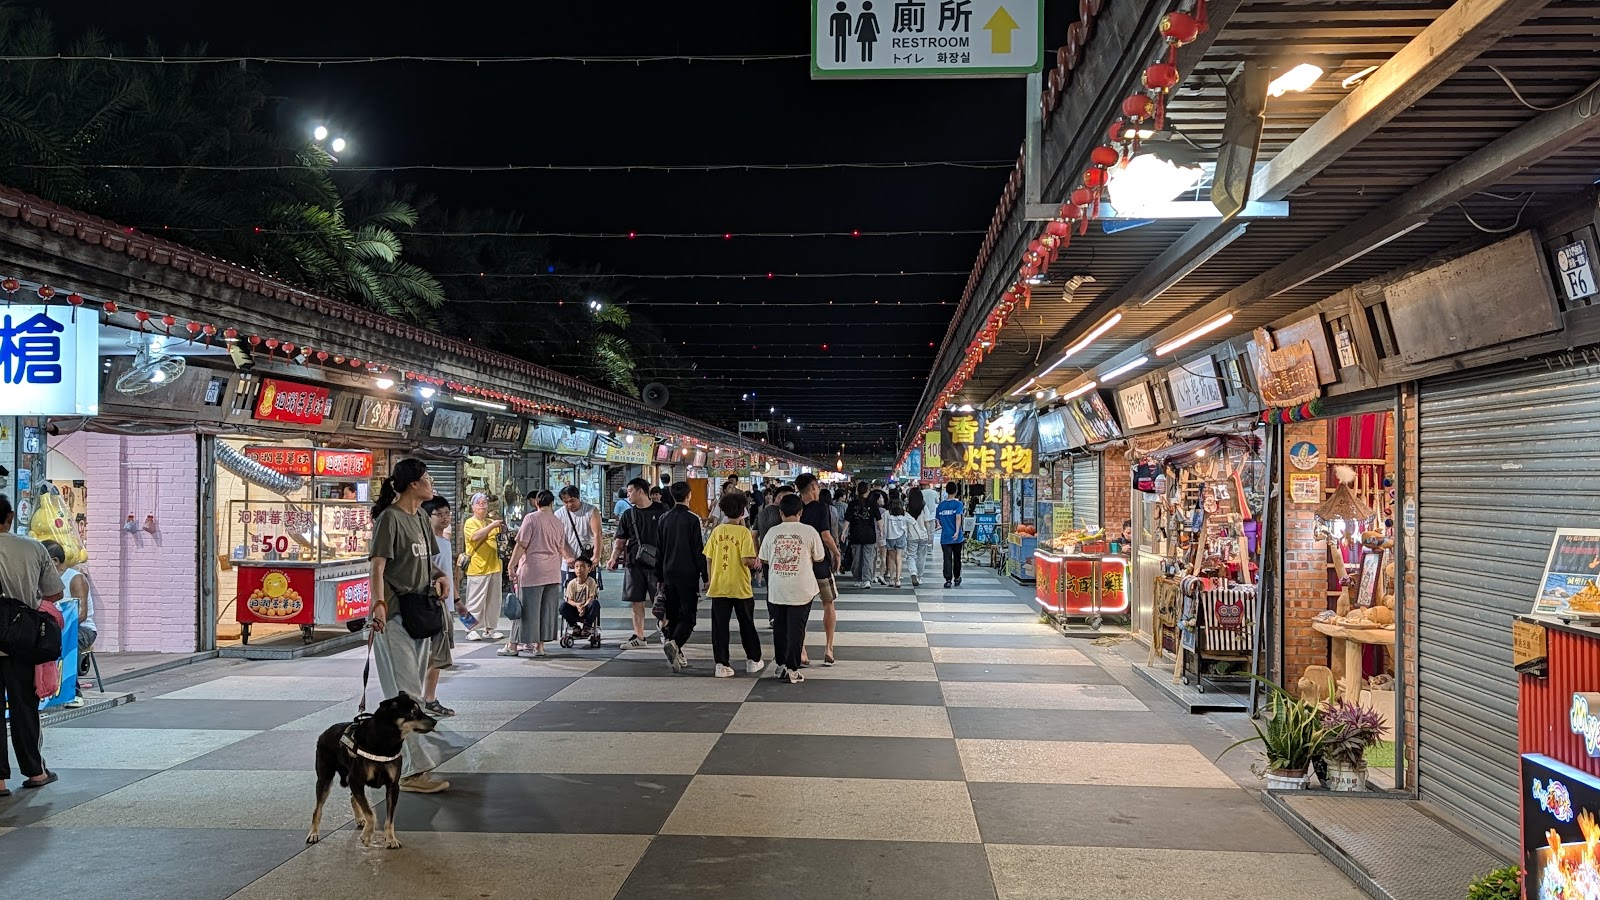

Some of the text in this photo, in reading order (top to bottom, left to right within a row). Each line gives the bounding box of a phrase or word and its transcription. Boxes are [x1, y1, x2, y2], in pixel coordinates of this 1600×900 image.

[892, 0, 973, 33] 廁所
[892, 37, 970, 48] RESTROOM
[893, 53, 925, 64] トイレ
[936, 51, 971, 64] 화장실
[1567, 270, 1588, 297] F6
[0, 312, 65, 385] 槍
[963, 444, 1033, 474] 炸物
[261, 535, 289, 553] 50
